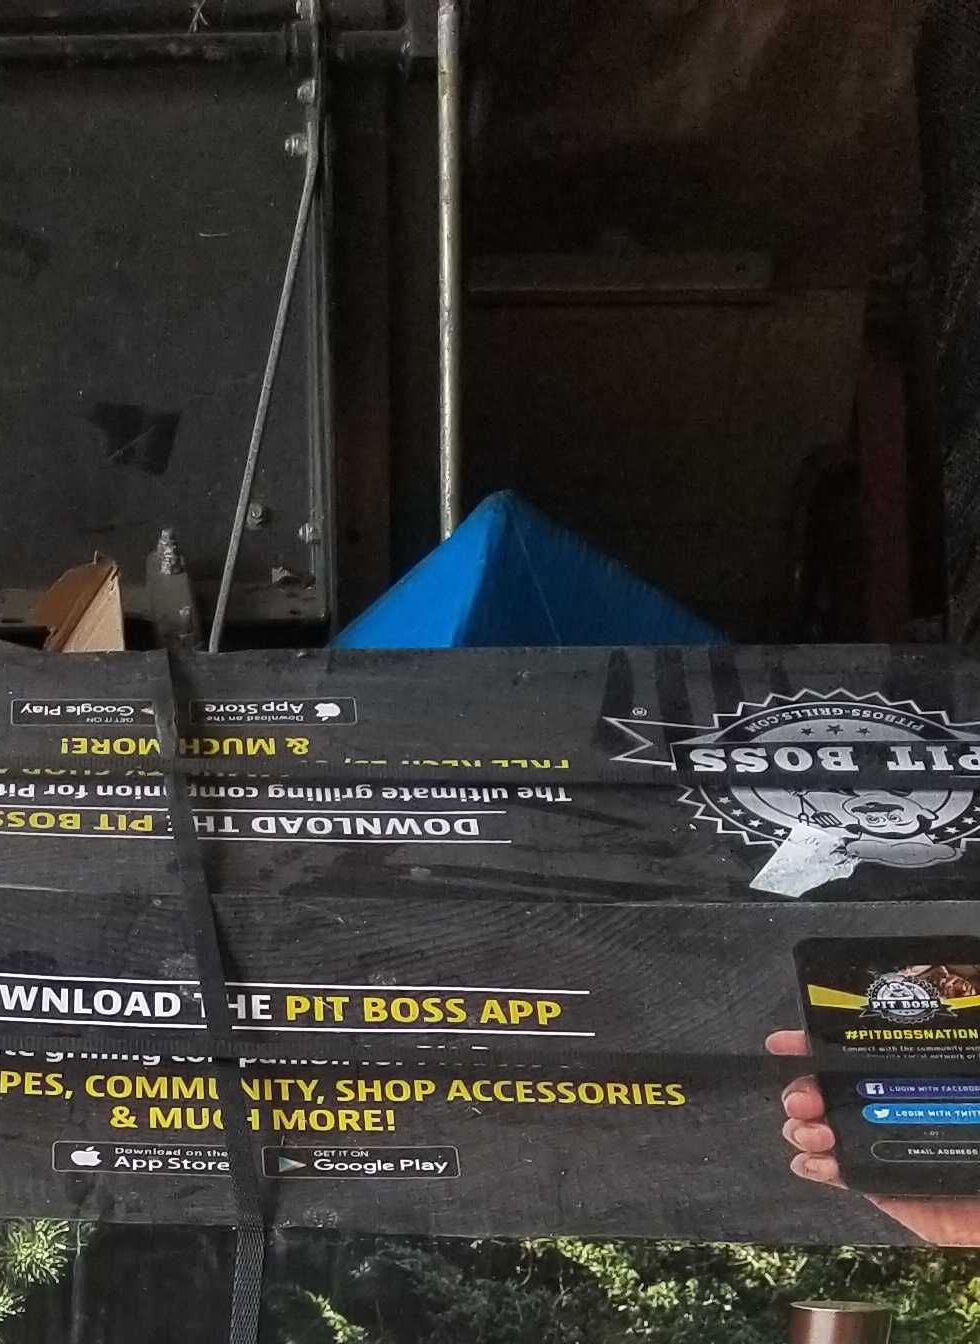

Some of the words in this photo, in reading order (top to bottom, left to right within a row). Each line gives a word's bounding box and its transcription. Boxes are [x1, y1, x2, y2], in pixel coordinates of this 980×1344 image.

[20, 703, 61, 714] Play
[66, 704, 134, 717] Google
[204, 703, 258, 714] Store
[262, 703, 305, 715] App
[744, 706, 926, 734] PITBOSS-GRILLS.COM
[179, 736, 276, 756] MUCH
[284, 737, 310, 754] &
[688, 746, 859, 773] BOSS
[43, 783, 90, 799] for
[268, 784, 372, 801] grilling
[381, 786, 510, 801] ultimate
[517, 786, 573, 802] The
[92, 814, 154, 833] PIT
[251, 817, 479, 836] DOWNLOAD
[285, 995, 351, 1023] PIT
[362, 996, 468, 1025] BOSS
[479, 998, 563, 1027] APP
[872, 999, 896, 1009] PIT
[904, 999, 940, 1010] BOSS
[335, 1079, 436, 1103] SHOP
[446, 1078, 687, 1107] ACCESSORIES
[109, 1105, 139, 1130] &
[273, 1108, 396, 1133] MORE!
[114, 1147, 182, 1157] Download
[206, 1149, 229, 1157] the
[114, 1156, 166, 1172] App
[169, 1157, 231, 1172] Store
[313, 1159, 394, 1175] Google
[399, 1159, 449, 1175] Play
